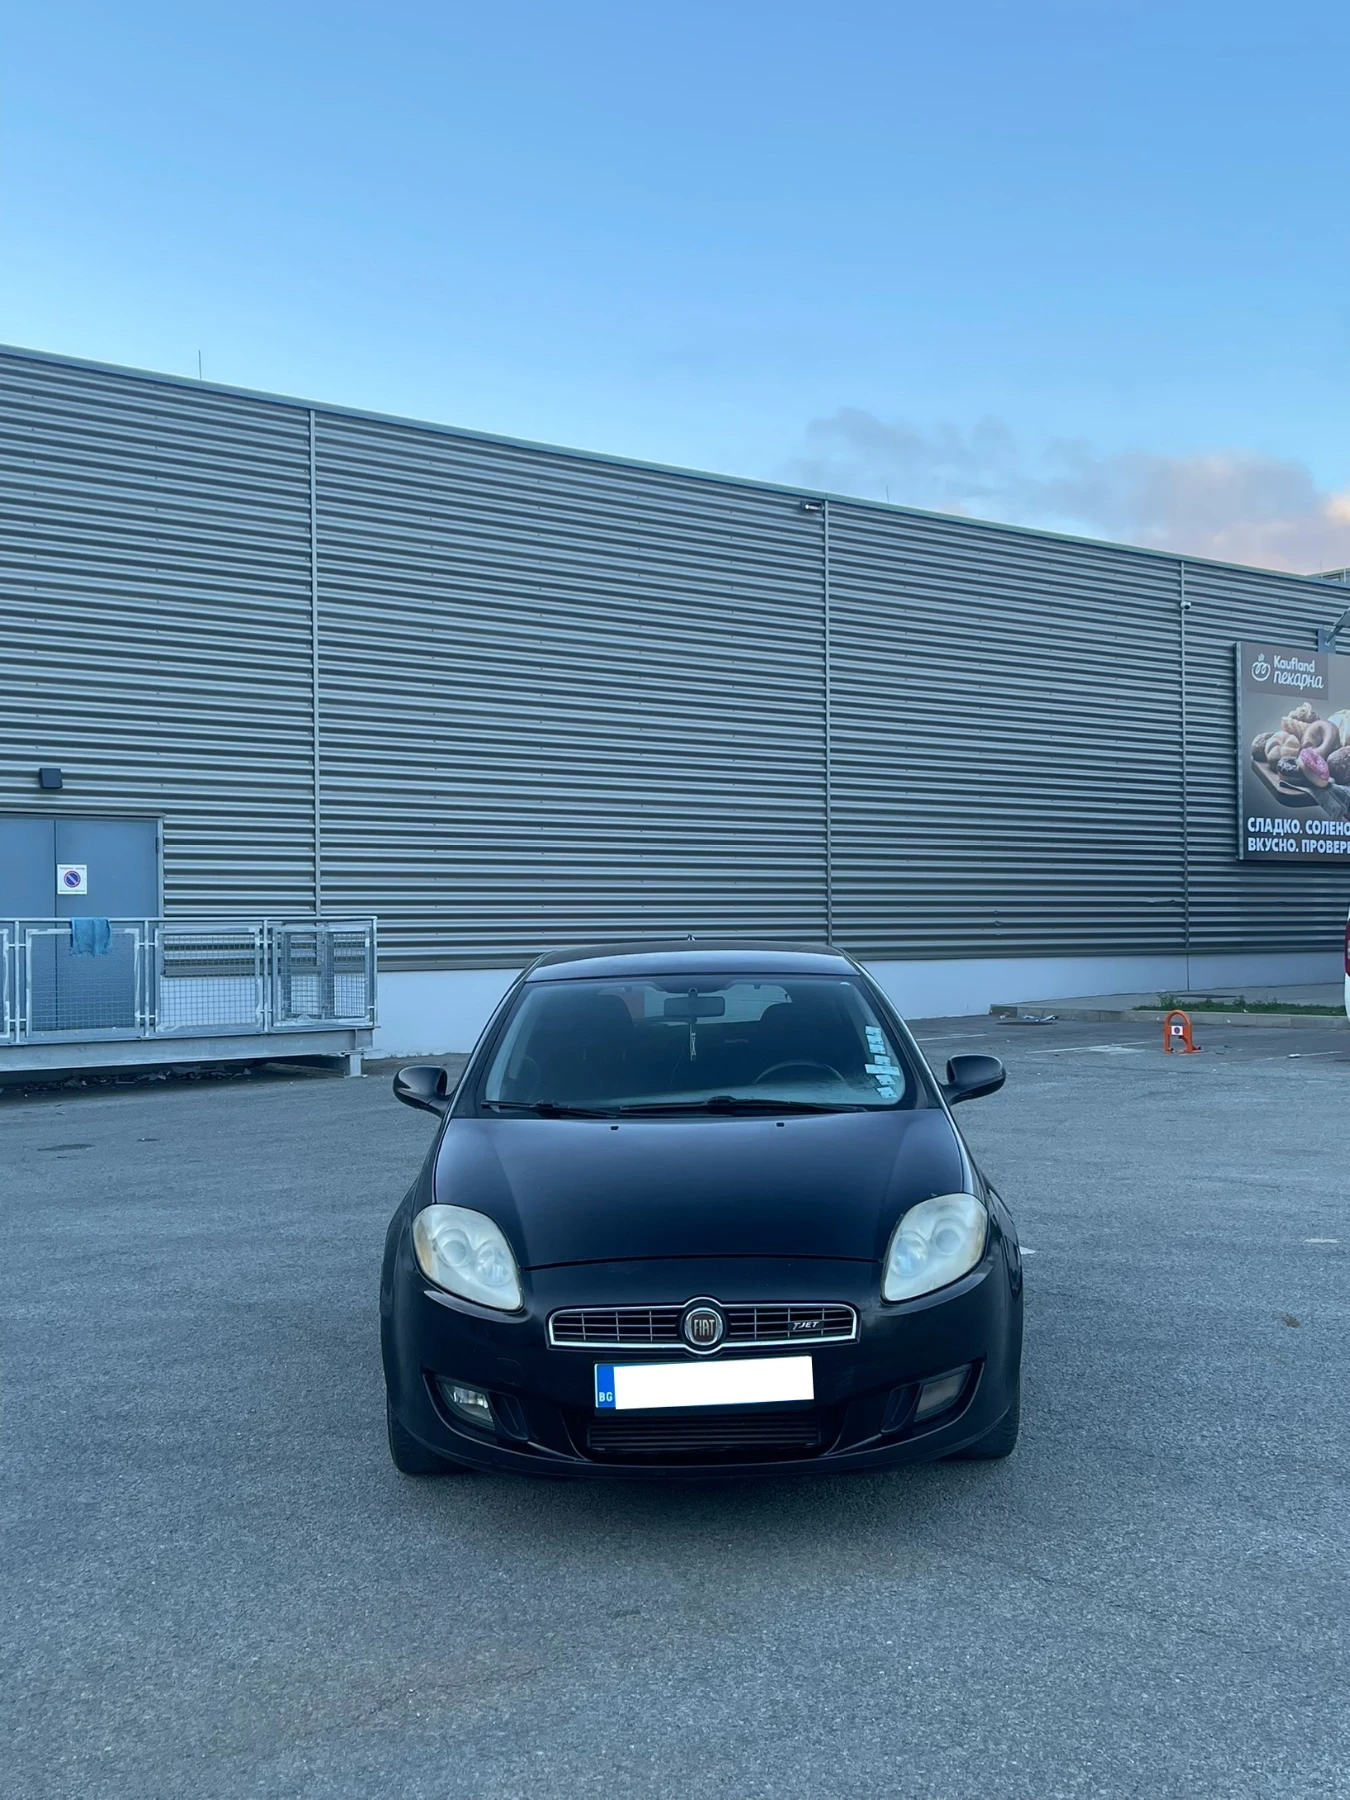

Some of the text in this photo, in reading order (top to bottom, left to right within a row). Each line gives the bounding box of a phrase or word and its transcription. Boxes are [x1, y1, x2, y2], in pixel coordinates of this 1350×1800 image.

[1273, 655, 1315, 673] Kaufland
[1273, 670, 1324, 690] пекарна
[1247, 817, 1303, 836] СЛАДКО.
[1247, 837, 1299, 853] ВКУСНО.
[693, 1319, 715, 1336] FIAT
[598, 1391, 613, 1402] BG
